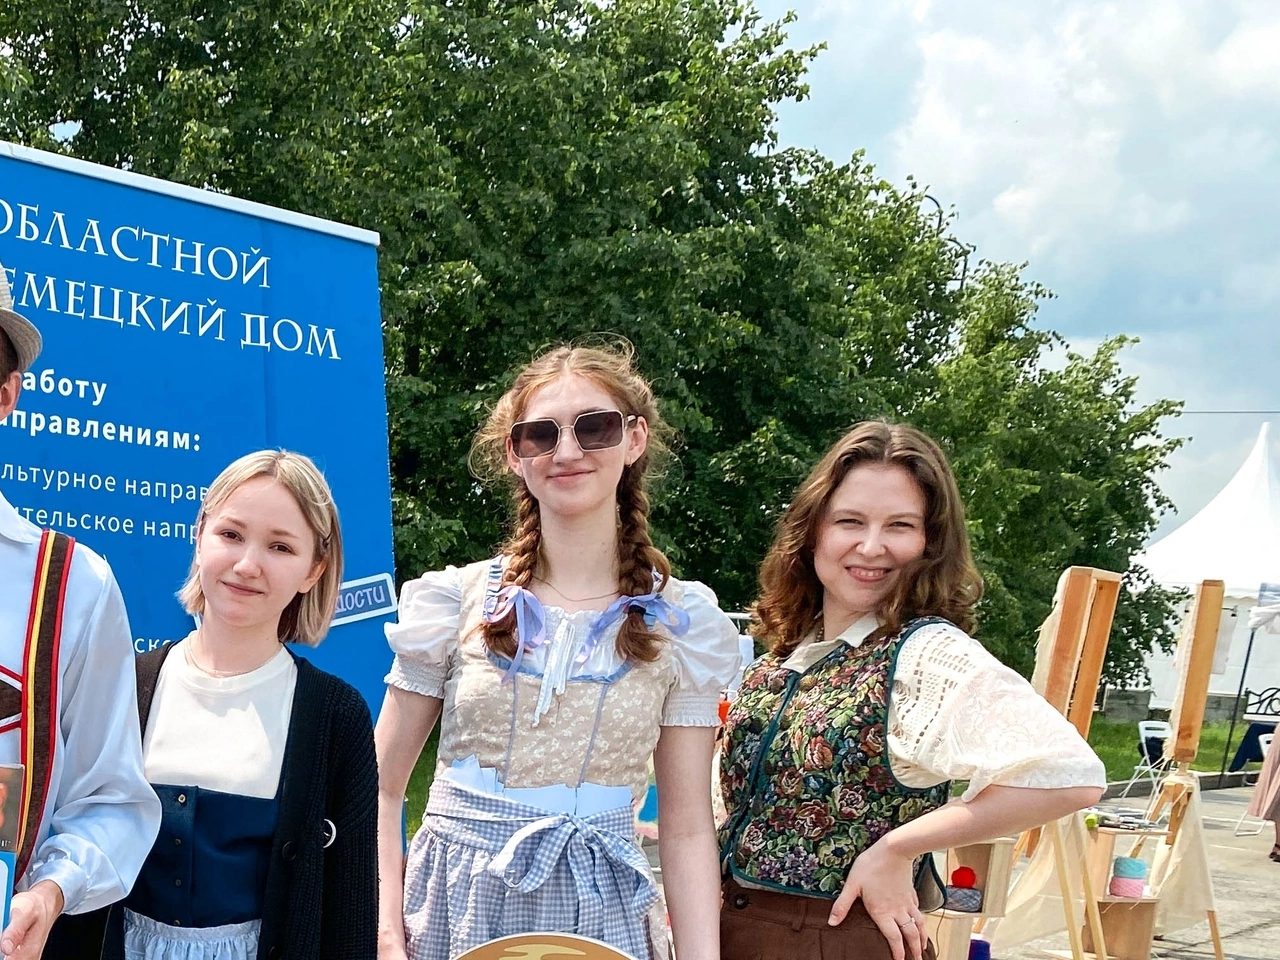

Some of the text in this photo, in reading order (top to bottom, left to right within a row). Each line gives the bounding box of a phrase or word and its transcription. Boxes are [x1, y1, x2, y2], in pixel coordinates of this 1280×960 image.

[240, 311, 342, 360] ДОМ
[22, 368, 108, 406] аботу
[125, 478, 209, 504] направ
[15, 506, 134, 535] тельское
[144, 520, 199, 545] напр
